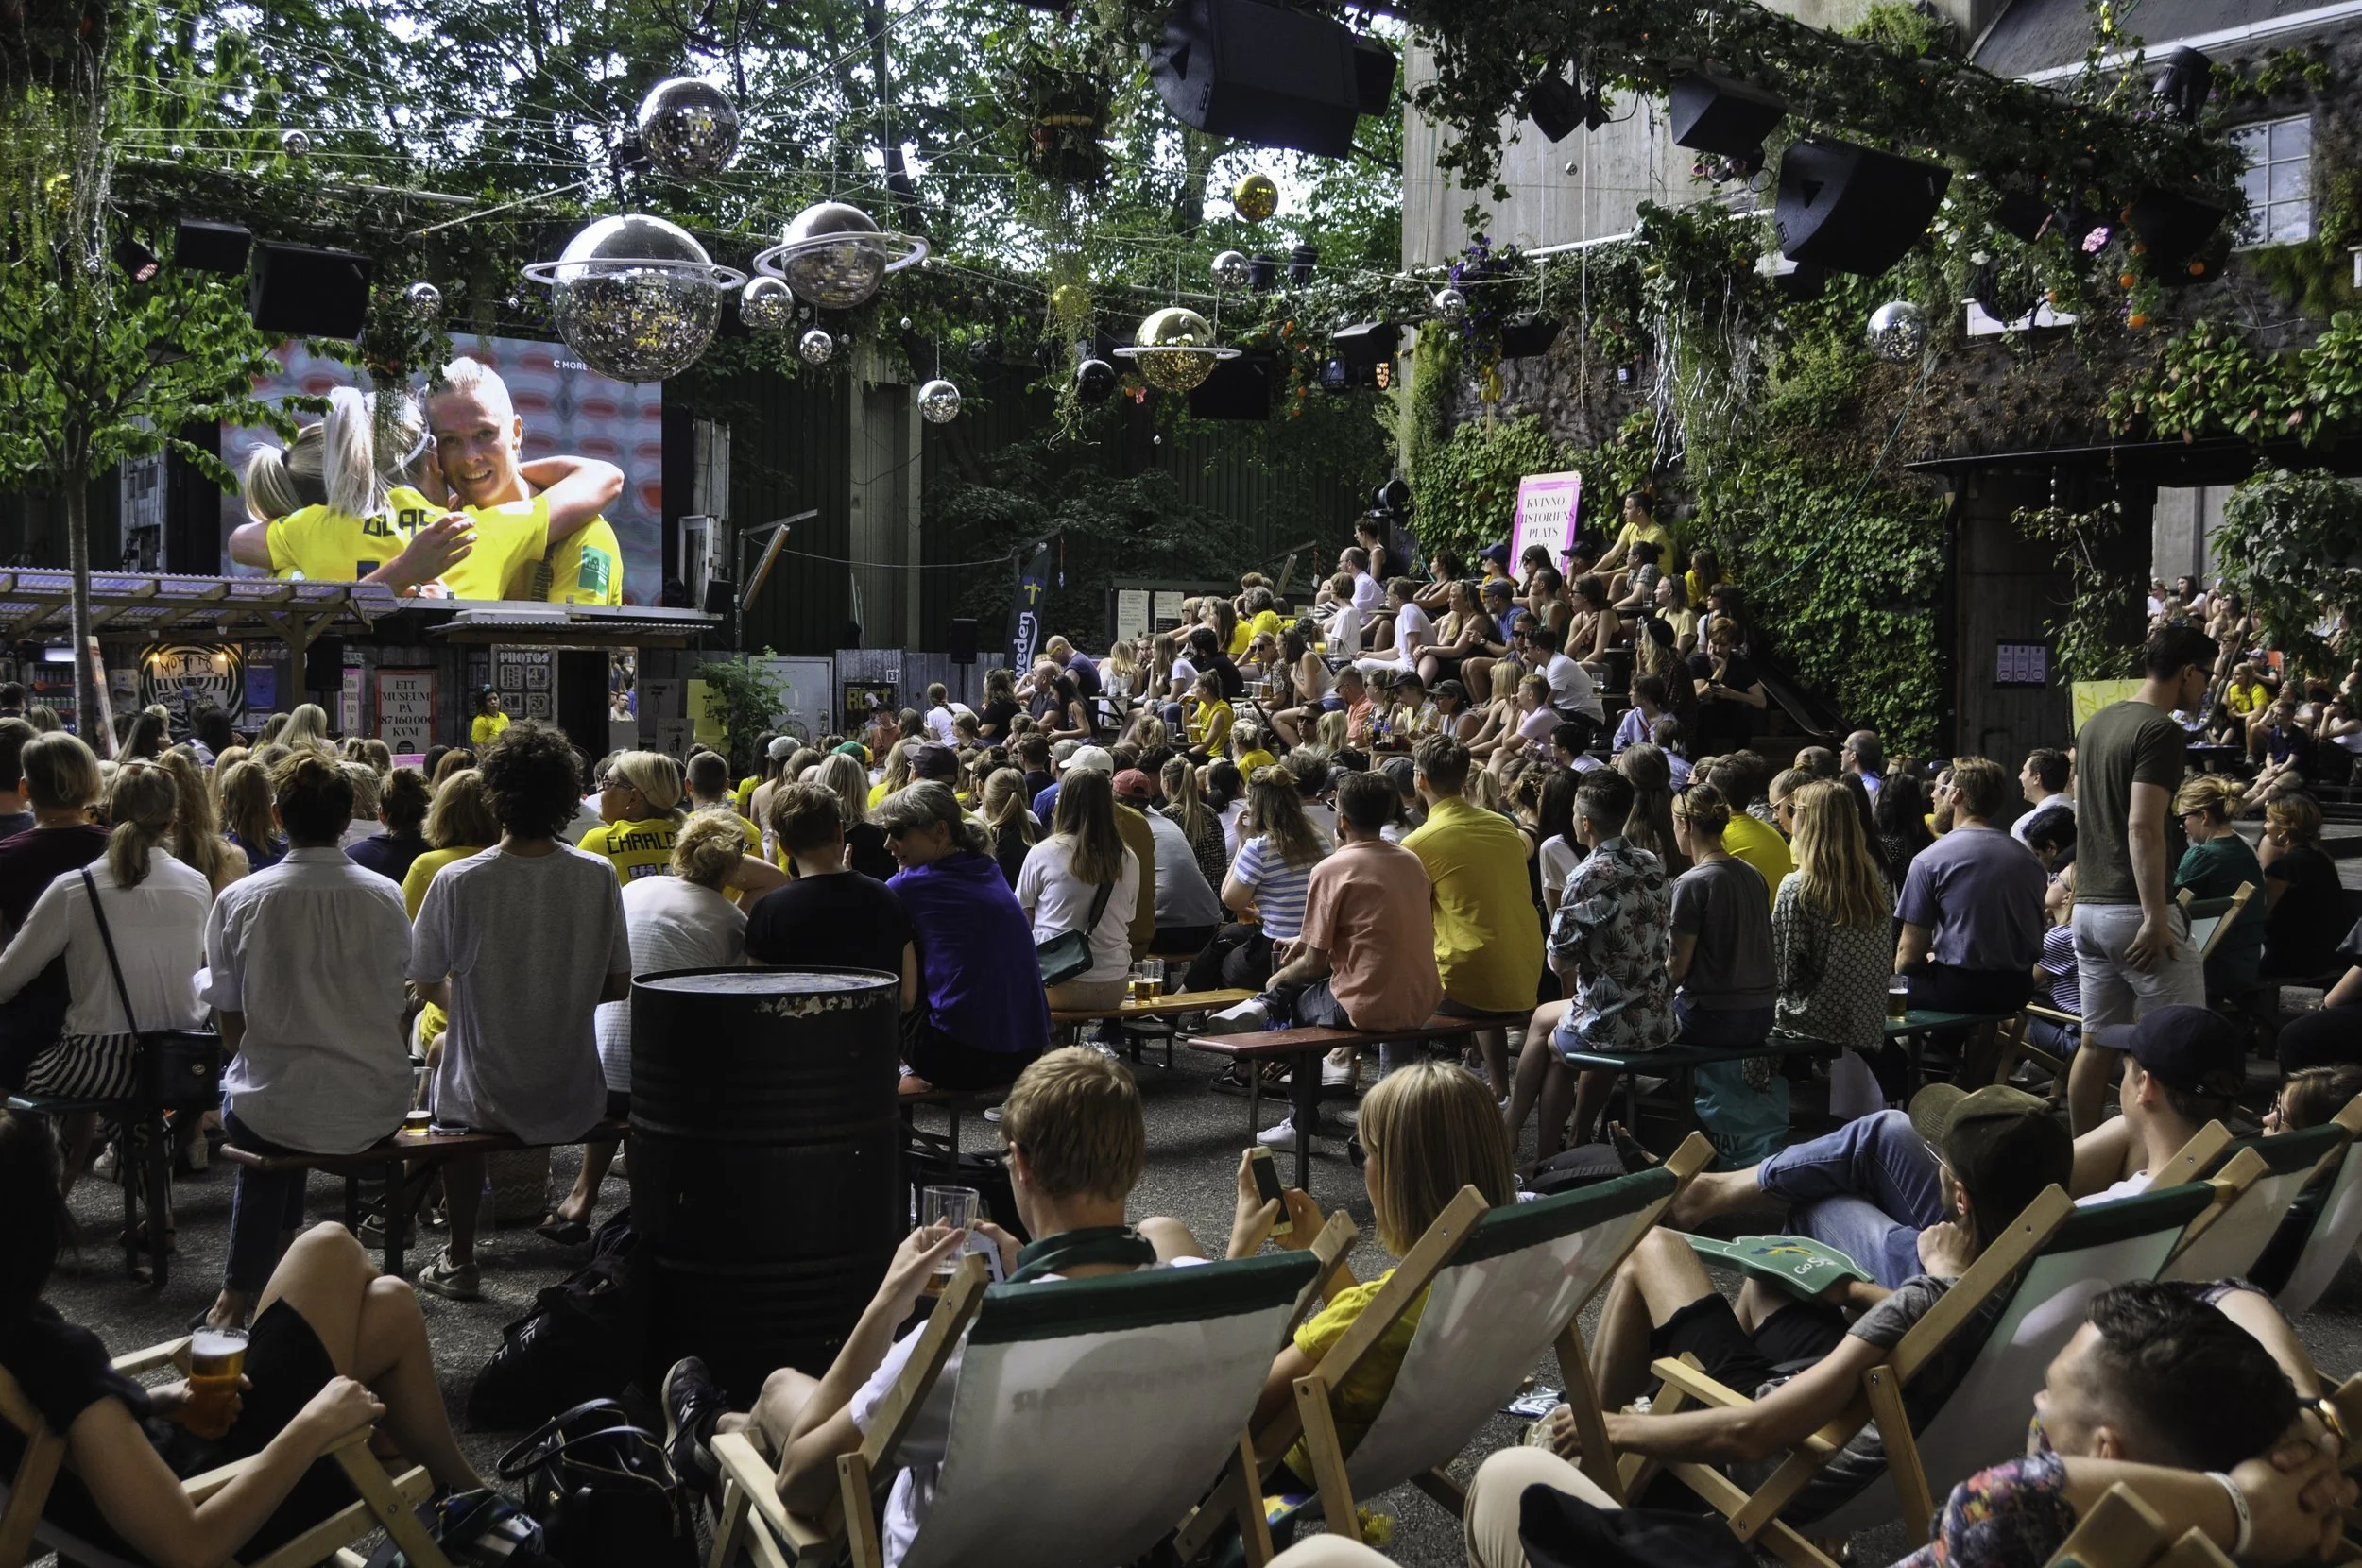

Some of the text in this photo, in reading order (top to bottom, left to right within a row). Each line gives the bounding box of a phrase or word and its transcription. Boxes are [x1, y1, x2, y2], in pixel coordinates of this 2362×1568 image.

[1517, 511, 1575, 524] HISTORIENS
[1529, 528, 1559, 538] PLATS
[1013, 610, 1034, 679] weden
[500, 652, 549, 663] PHOTOS
[396, 680, 417, 690] ETT
[383, 691, 430, 701] MUSEUM
[399, 702, 413, 712] PÅ
[392, 727, 419, 736] KVM
